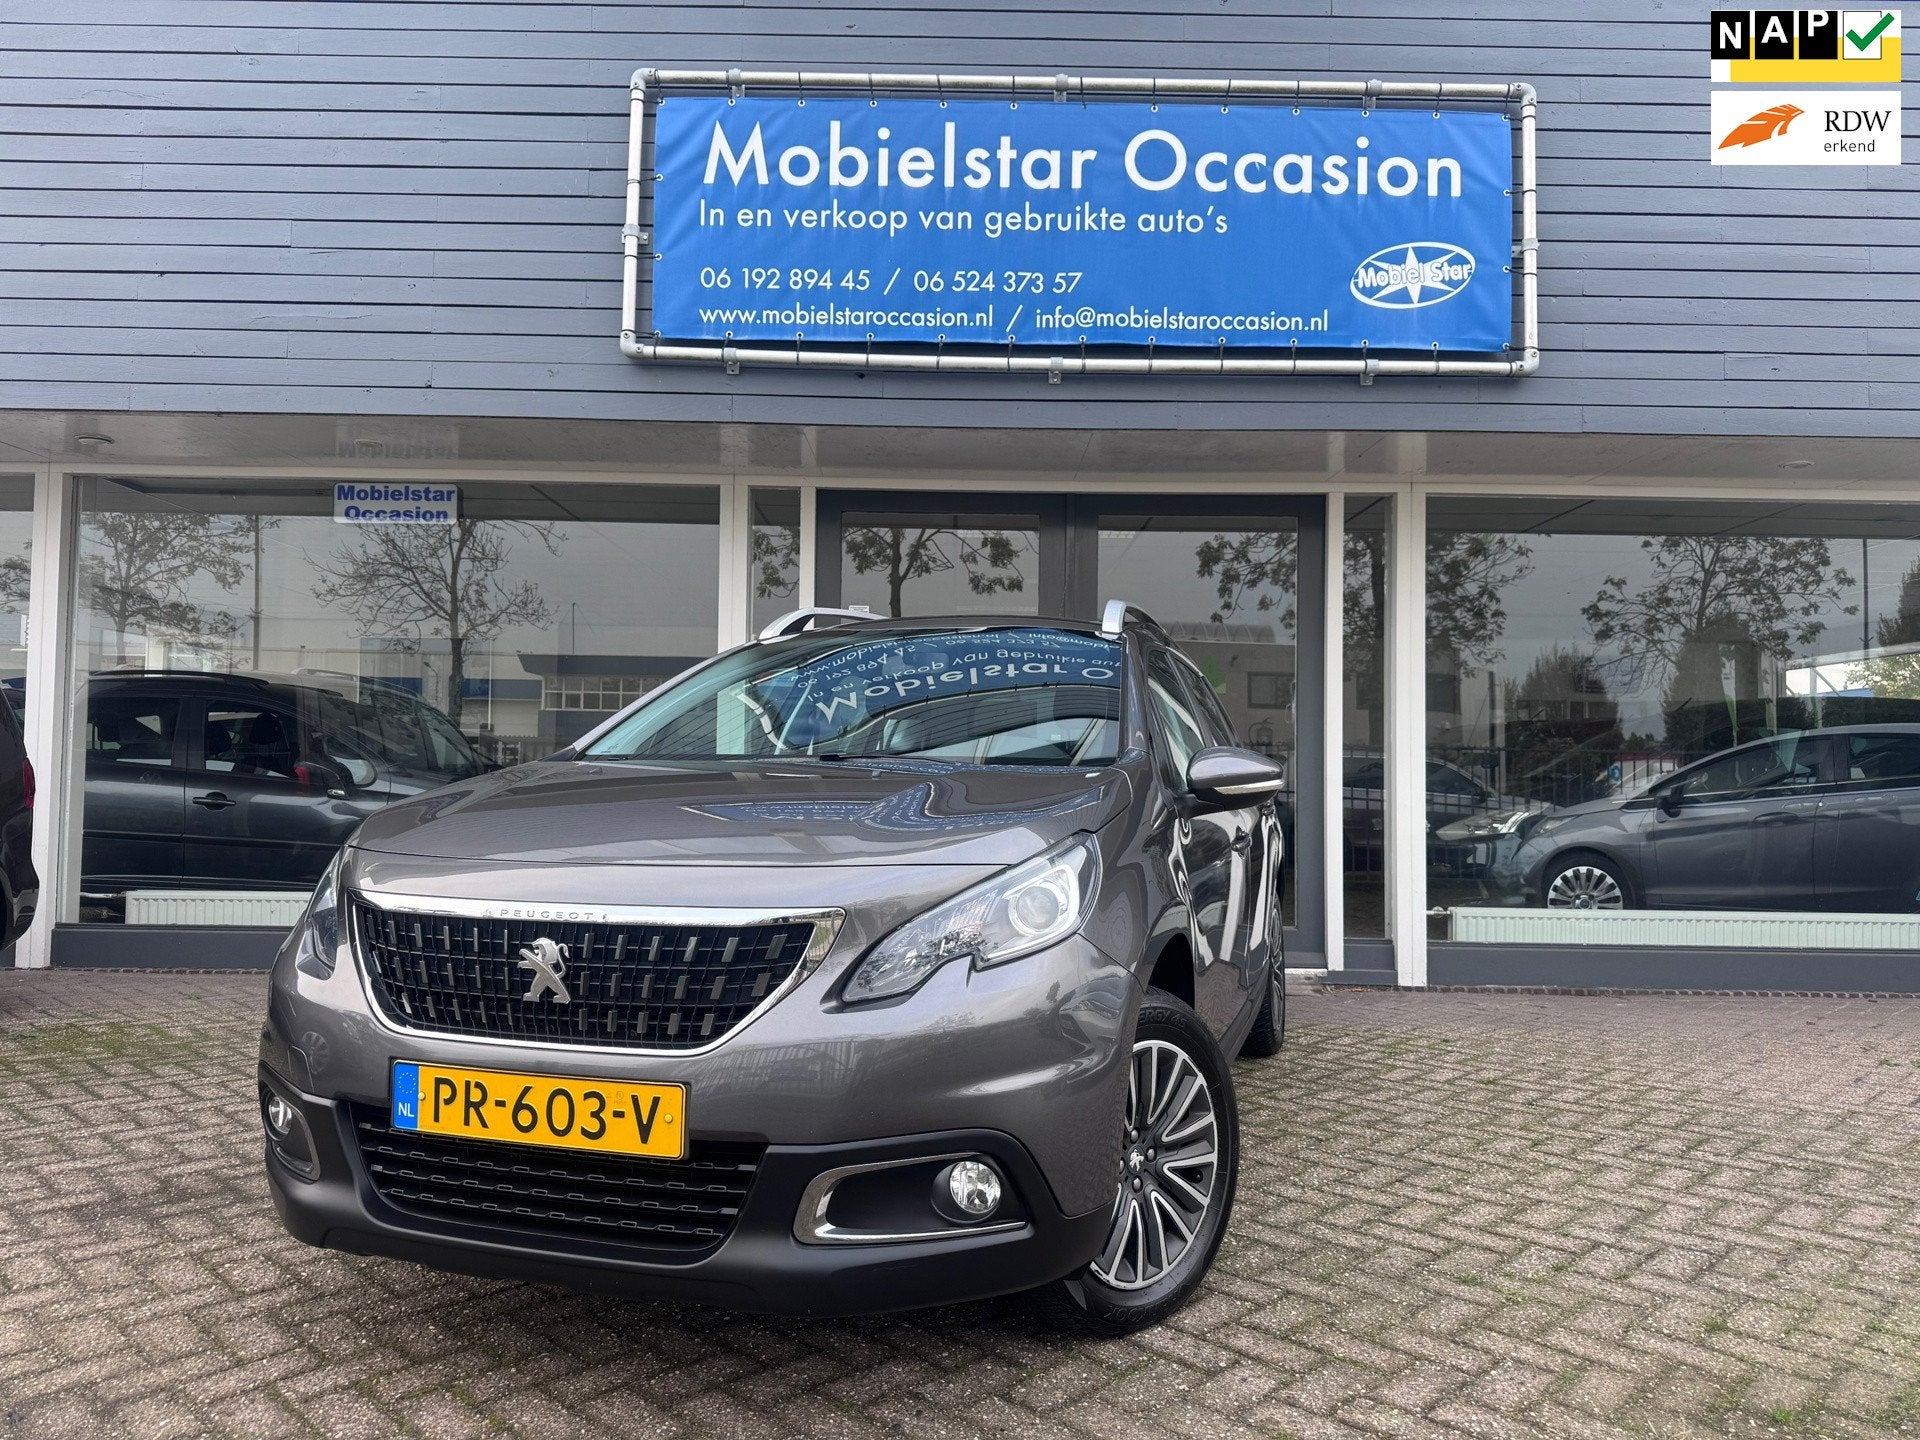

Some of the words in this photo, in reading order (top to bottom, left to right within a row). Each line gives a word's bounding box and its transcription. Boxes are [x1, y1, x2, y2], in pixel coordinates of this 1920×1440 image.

[704, 119, 1097, 190] Mobielstar
[1125, 129, 1462, 198] Occasion
[700, 199, 724, 227] In
[737, 208, 772, 228] en
[783, 199, 908, 238] verkoop
[918, 211, 972, 230] van
[985, 202, 1126, 238] gebruikte
[1137, 205, 1228, 233] auto's
[700, 267, 731, 289] 06
[743, 267, 780, 289] 192
[789, 268, 833, 290] 894
[839, 269, 870, 291] 45
[913, 270, 944, 292] 06
[951, 270, 995, 292] 524
[1003, 271, 1044, 294] 373
[1052, 272, 1083, 294] 57
[1358, 262, 1425, 288] Mobiel
[1431, 262, 1471, 282] Star
[699, 302, 993, 328] www.mobielstaroccasion.nl
[1036, 306, 1328, 331] info@mobielstaroccasion.nl
[337, 485, 455, 501] Mobielstar
[344, 506, 448, 522] Occasion
[500, 909, 594, 920] PEUGEOT
[398, 1102, 415, 1118] NL
[433, 1076, 661, 1145] PR-603-V
